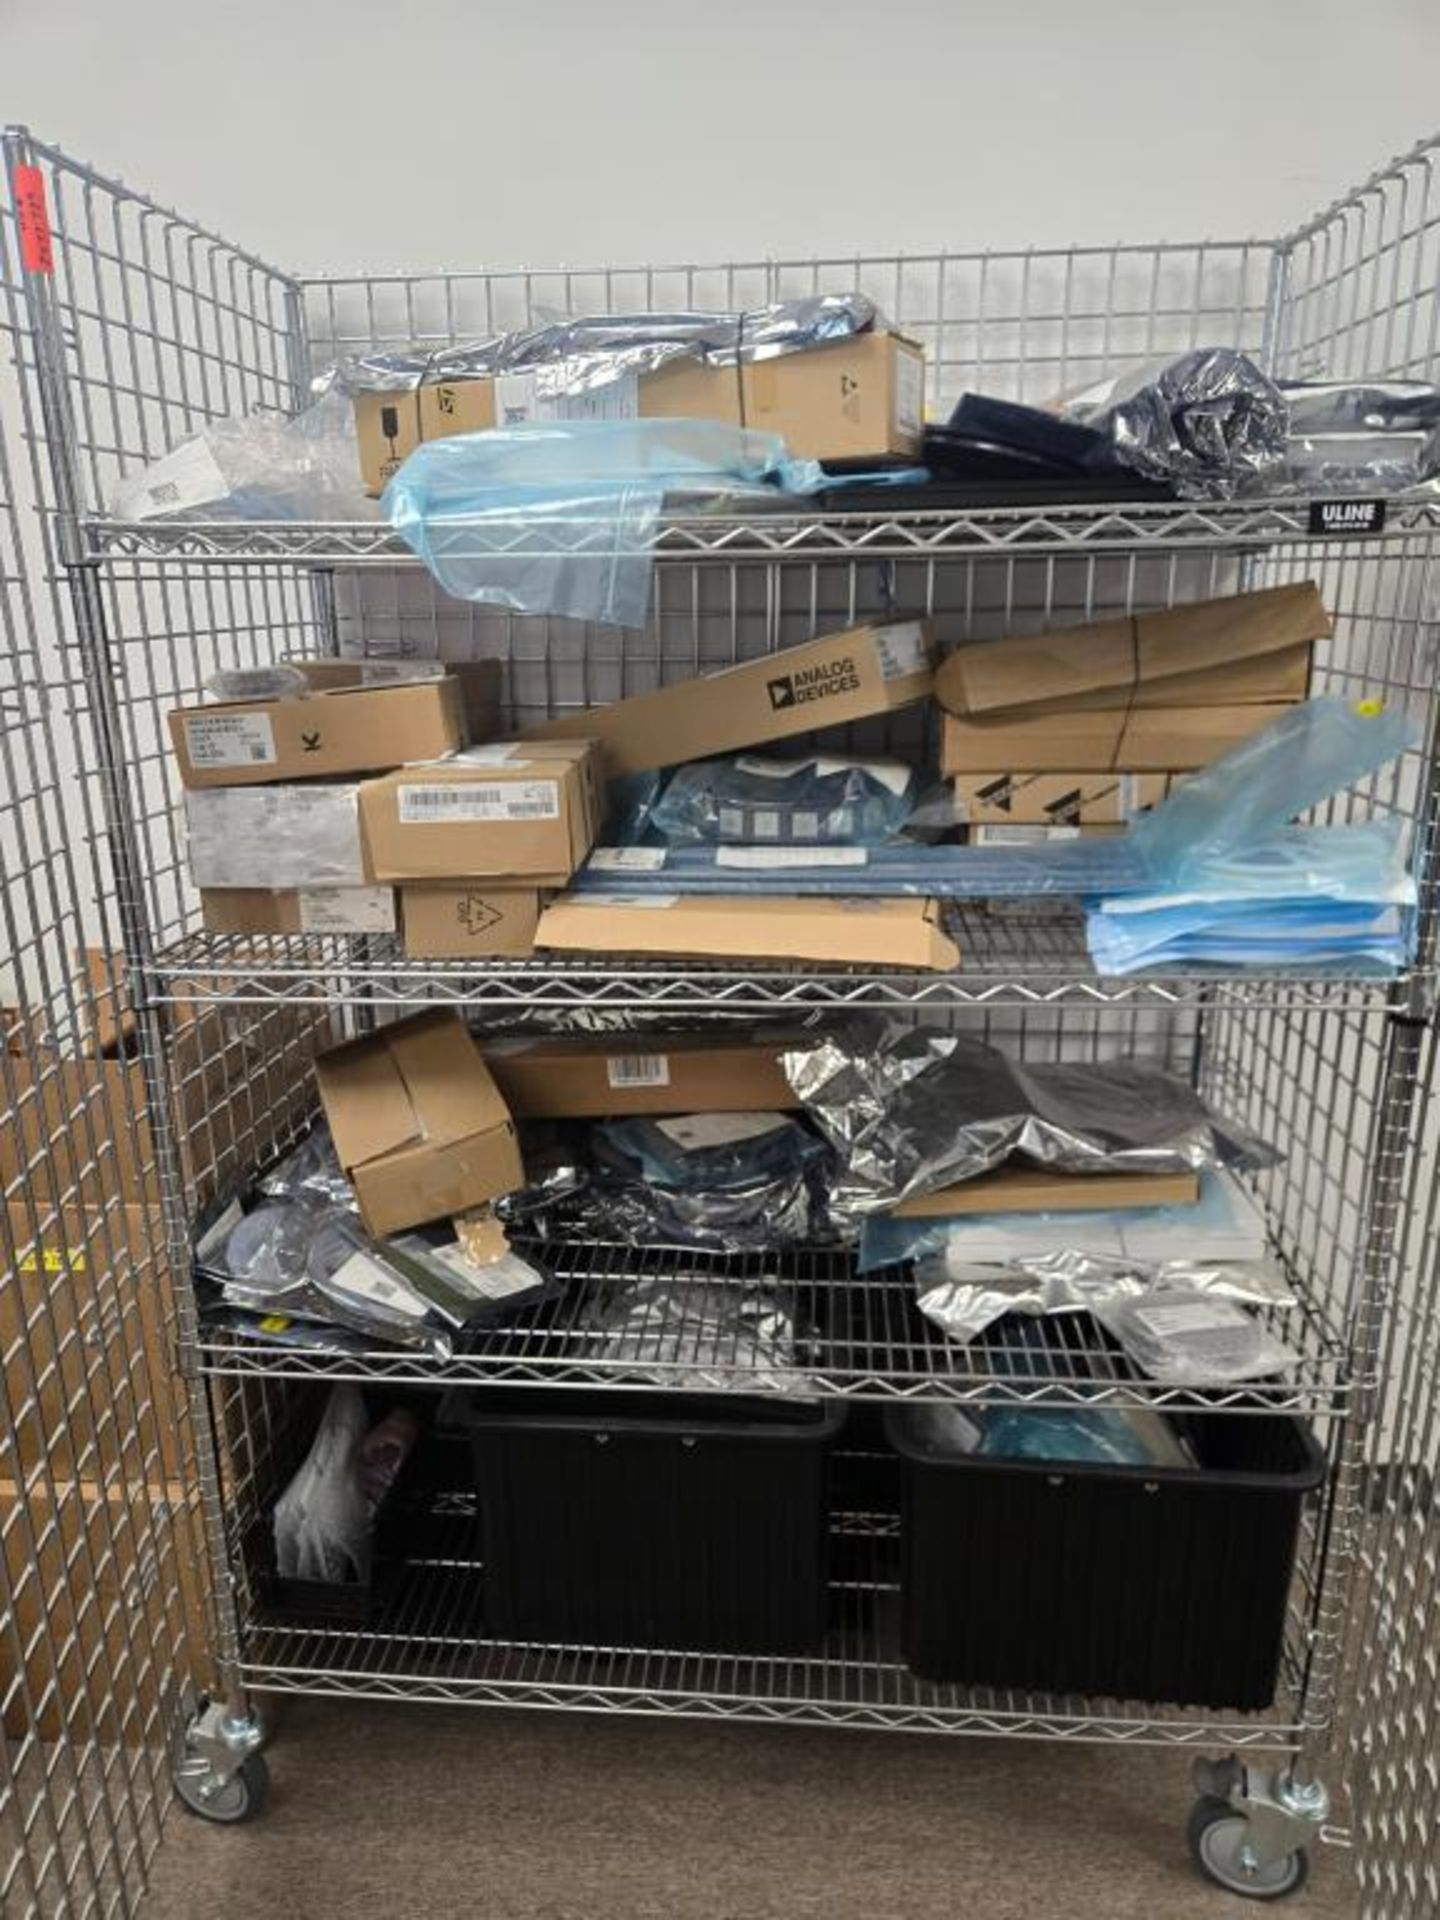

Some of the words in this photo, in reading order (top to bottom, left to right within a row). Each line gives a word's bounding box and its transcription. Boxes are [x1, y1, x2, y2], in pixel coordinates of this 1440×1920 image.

[1322, 503, 1376, 521] ULINE
[794, 658, 855, 687] ANALOG
[797, 674, 860, 703] DEVICES
